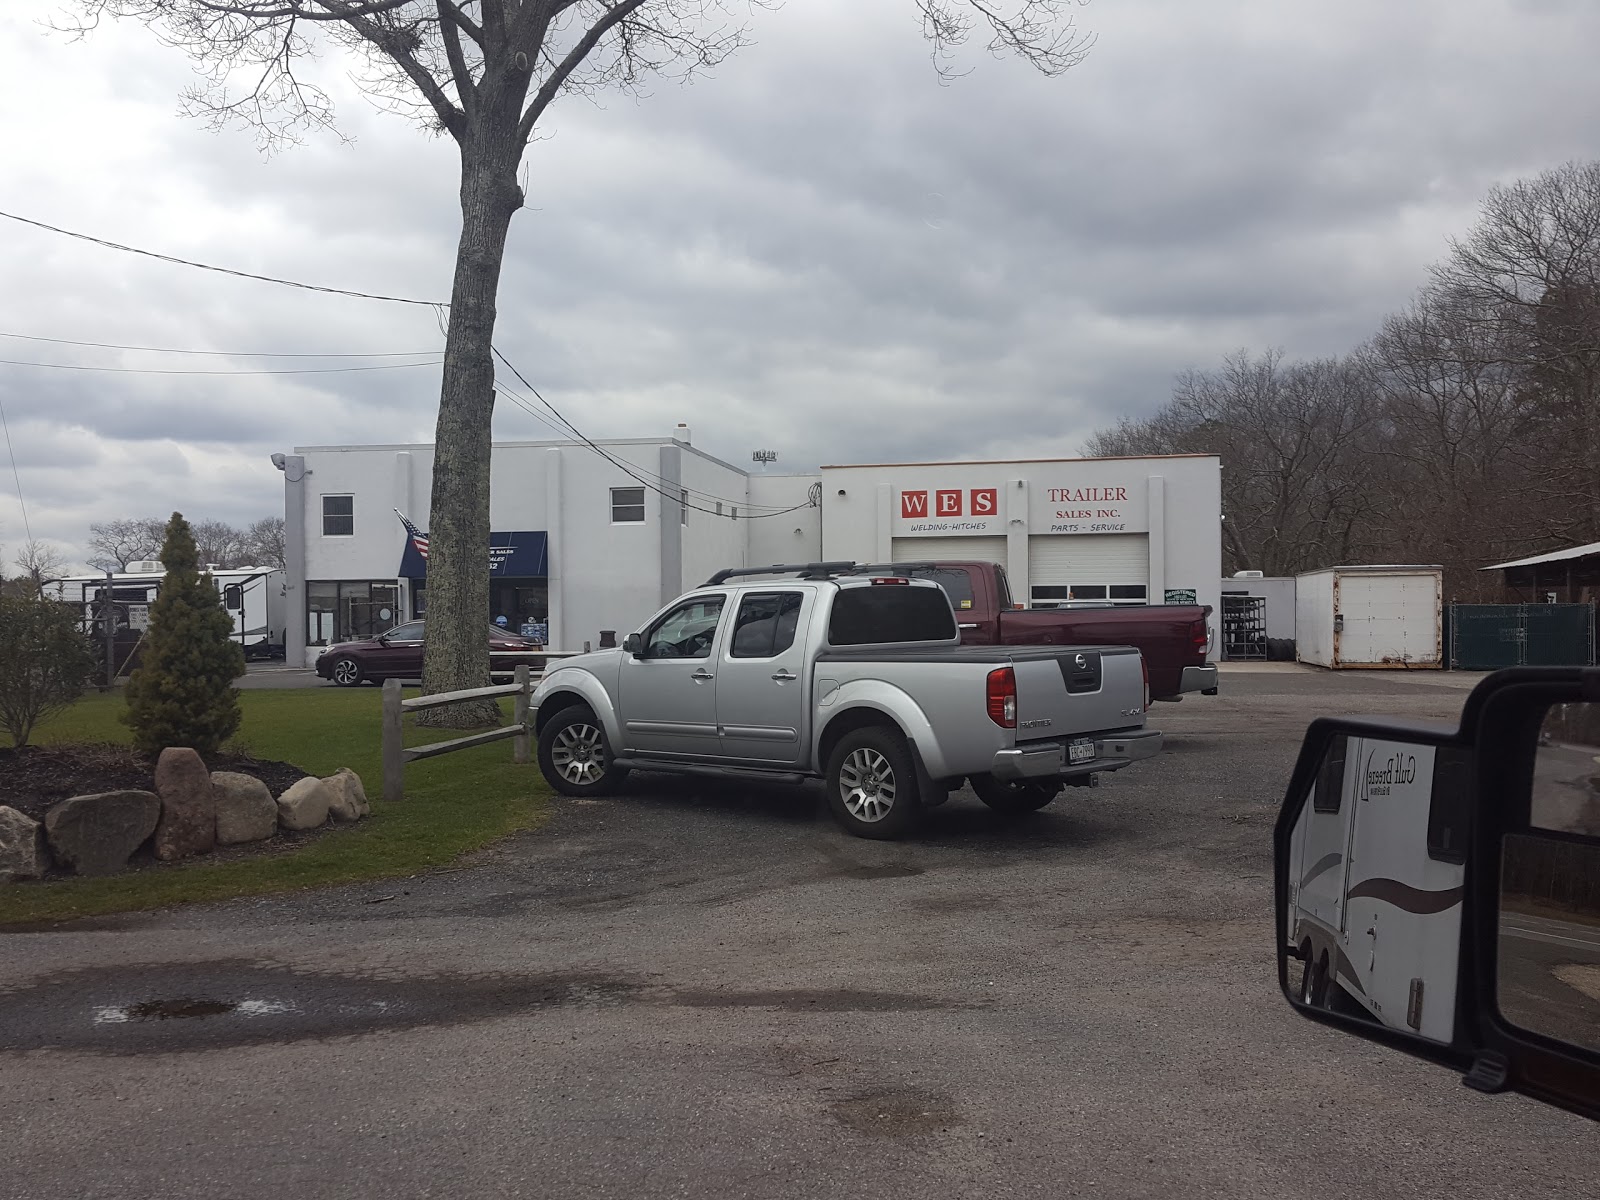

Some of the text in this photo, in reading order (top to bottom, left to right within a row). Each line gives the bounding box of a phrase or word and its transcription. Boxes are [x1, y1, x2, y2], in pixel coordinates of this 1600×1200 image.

[1048, 487, 1128, 503] TRAILER
[1056, 509, 1121, 519] SALES INC.
[1051, 524, 1079, 532] PARTS
[1090, 523, 1126, 532] SERVICE
[1165, 590, 1196, 598] REGISTERED
[1020, 719, 1052, 729] FRONTIER
